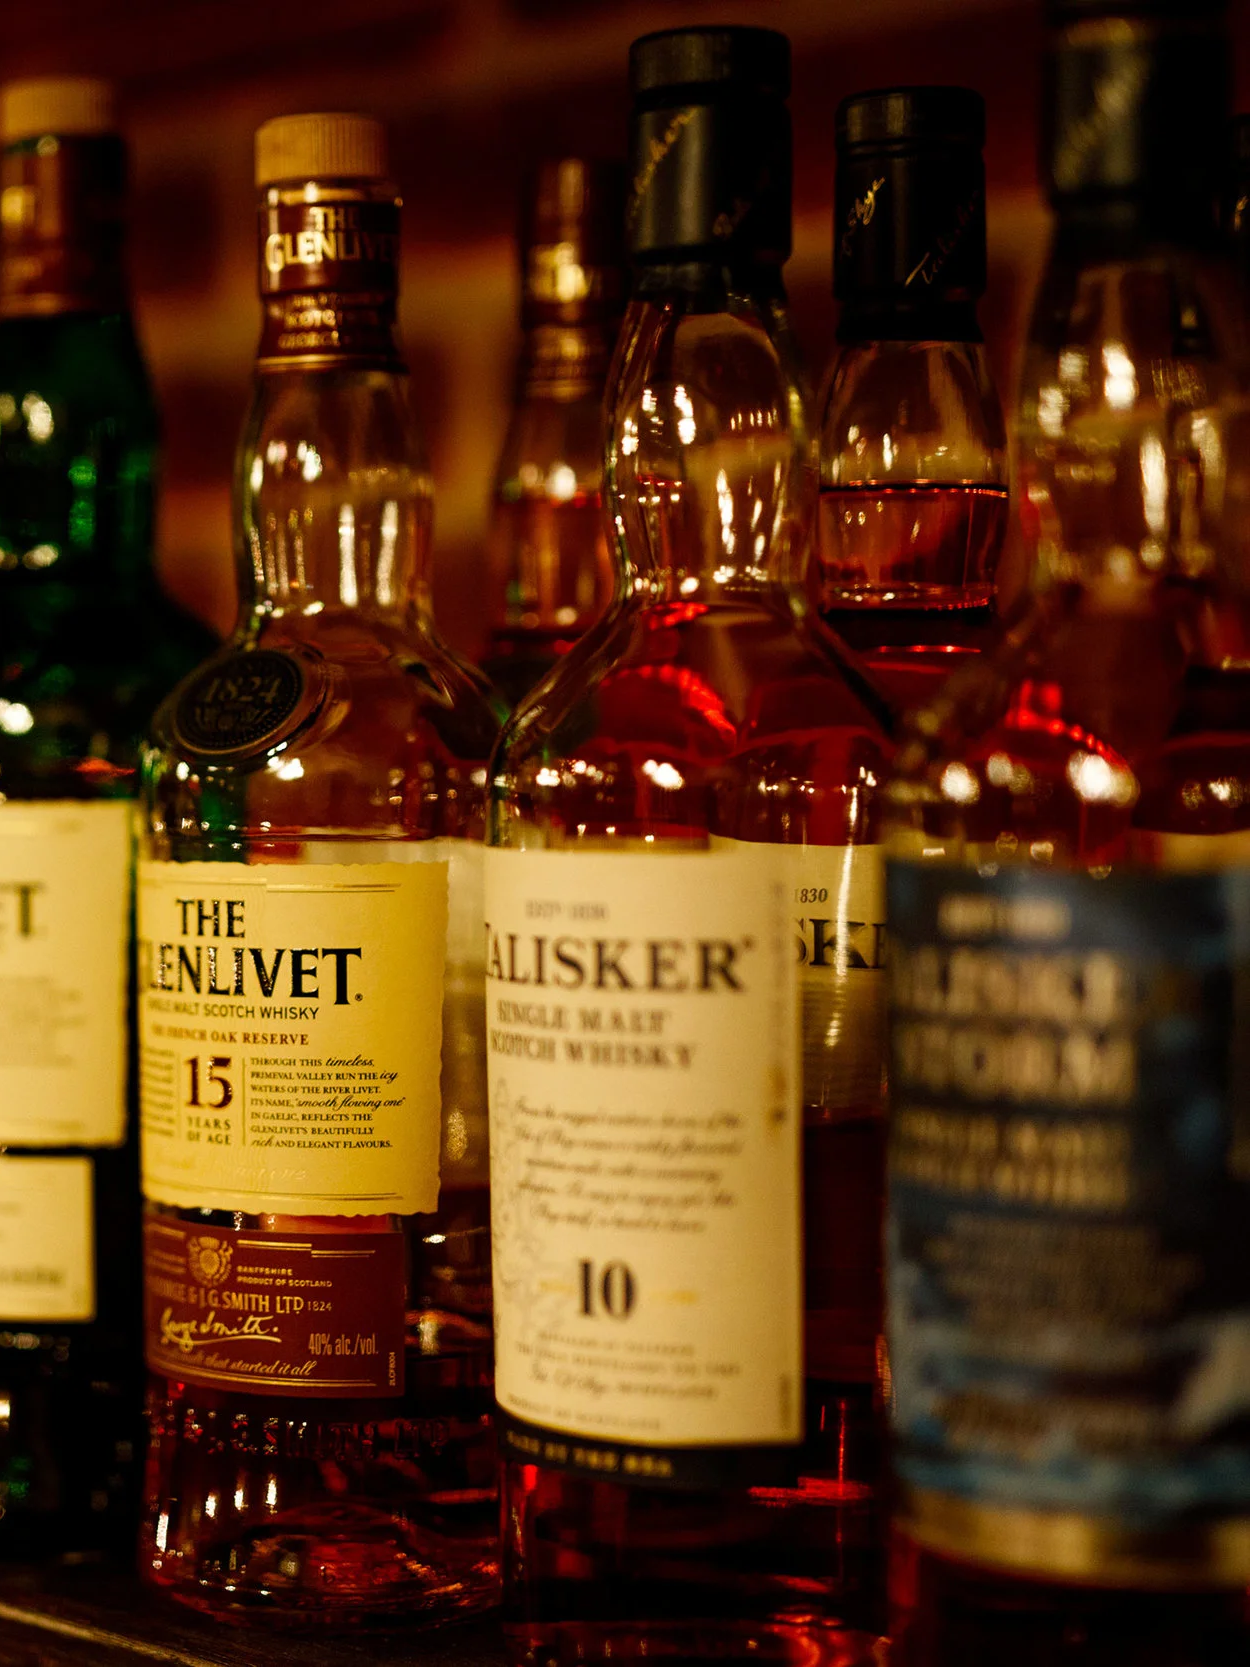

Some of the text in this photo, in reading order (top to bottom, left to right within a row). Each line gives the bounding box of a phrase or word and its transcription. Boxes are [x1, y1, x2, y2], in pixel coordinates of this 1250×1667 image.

[176, 898, 245, 938] THE
[174, 1000, 199, 1015] MALT
[204, 1005, 254, 1019] SCOTCH
[260, 1006, 319, 1020] WHISKY
[211, 1031, 237, 1043] OAK
[243, 1032, 309, 1046] RESERVE
[250, 1057, 296, 1067] THROUGH
[300, 1058, 322, 1067] THIS
[184, 1056, 233, 1110] 15
[250, 1071, 294, 1080] PRIMEVAL
[296, 1072, 332, 1081] VALLEY
[335, 1073, 356, 1081] RUN
[380, 1070, 398, 1084] icy
[250, 1085, 381, 1094] WATERS OF THE RIVER LIVET.
[250, 1098, 265, 1106] ITS
[266, 1098, 294, 1108] NAME,
[333, 1095, 381, 1111] flowing
[187, 1116, 231, 1130] YEARS
[250, 1112, 261, 1120] IN
[301, 1113, 349, 1121] REFLECTS
[352, 1113, 373, 1121] THE
[311, 1127, 374, 1135] BEAUTIFULLY
[207, 1133, 231, 1145] AGE
[252, 1136, 393, 1148] rich AND ELEGANT FLAVOURS.
[237, 1276, 273, 1286] PRODUCT
[288, 1279, 333, 1288] SCOTLAND
[578, 1257, 638, 1322] 10
[222, 1291, 270, 1313] SMITH
[308, 1301, 332, 1311] 1824
[308, 1333, 332, 1355] 40%
[230, 1360, 280, 1374] started
[278, 1362, 291, 1375] it
[291, 1360, 318, 1376] all
